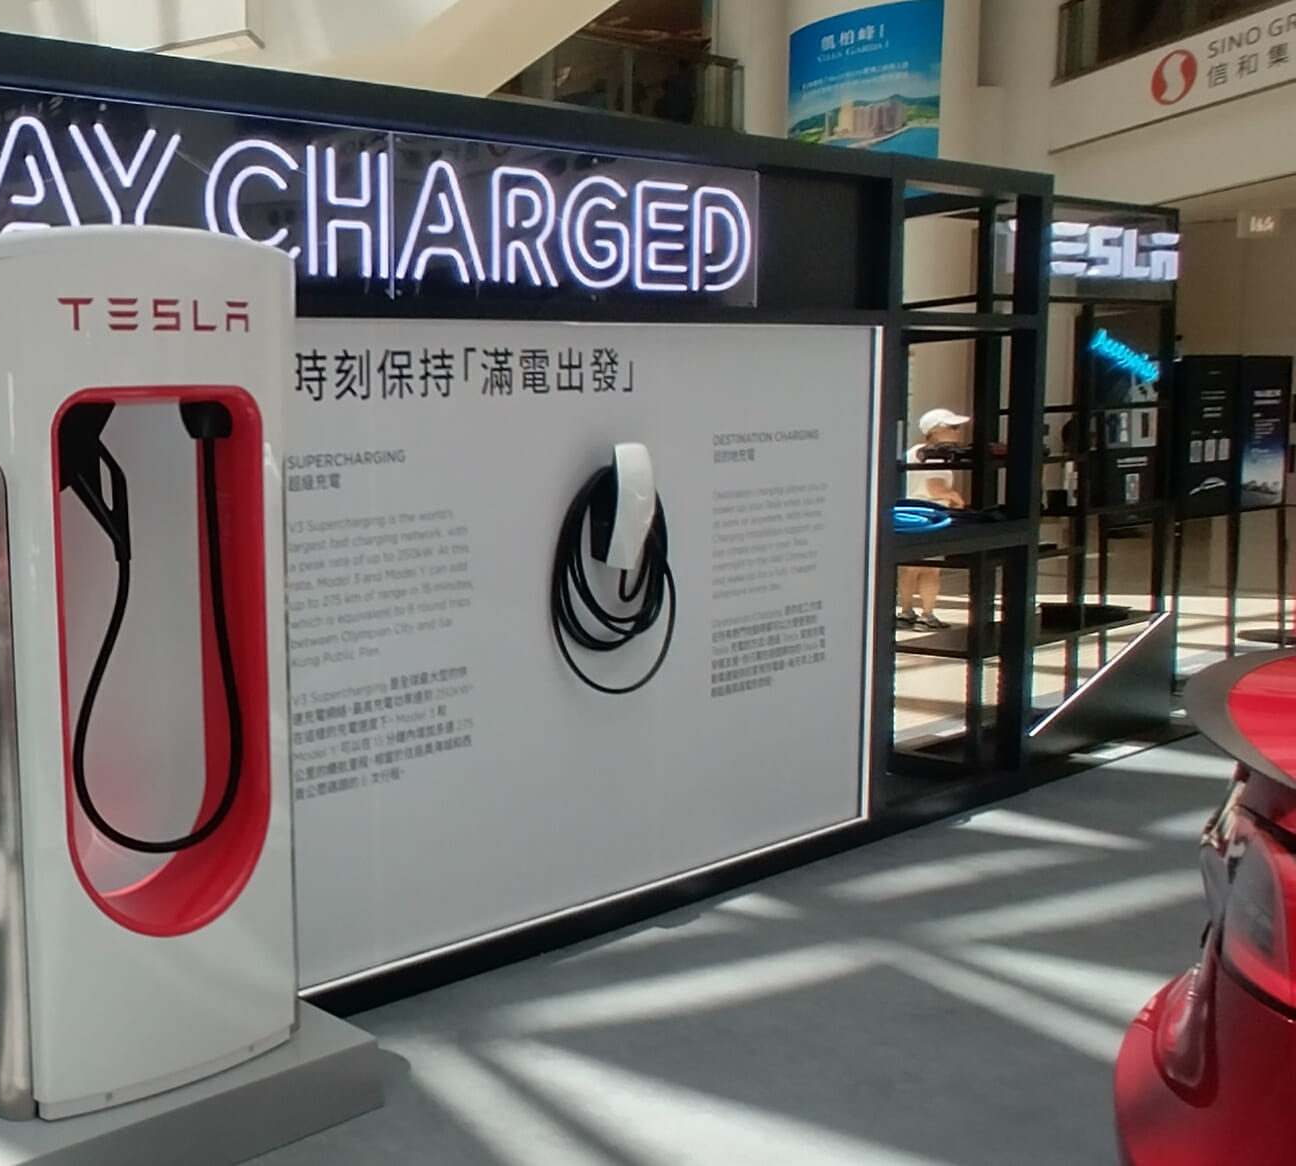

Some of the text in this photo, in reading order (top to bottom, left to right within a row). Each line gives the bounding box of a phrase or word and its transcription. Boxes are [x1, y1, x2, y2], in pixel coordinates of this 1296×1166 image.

[1207, 26, 1261, 59] SINO
[205, 139, 752, 292] CHARGED
[1008, 219, 1181, 281] ESLA
[57, 298, 249, 332] TESLA
[288, 450, 406, 470] SUPERCHARGING
